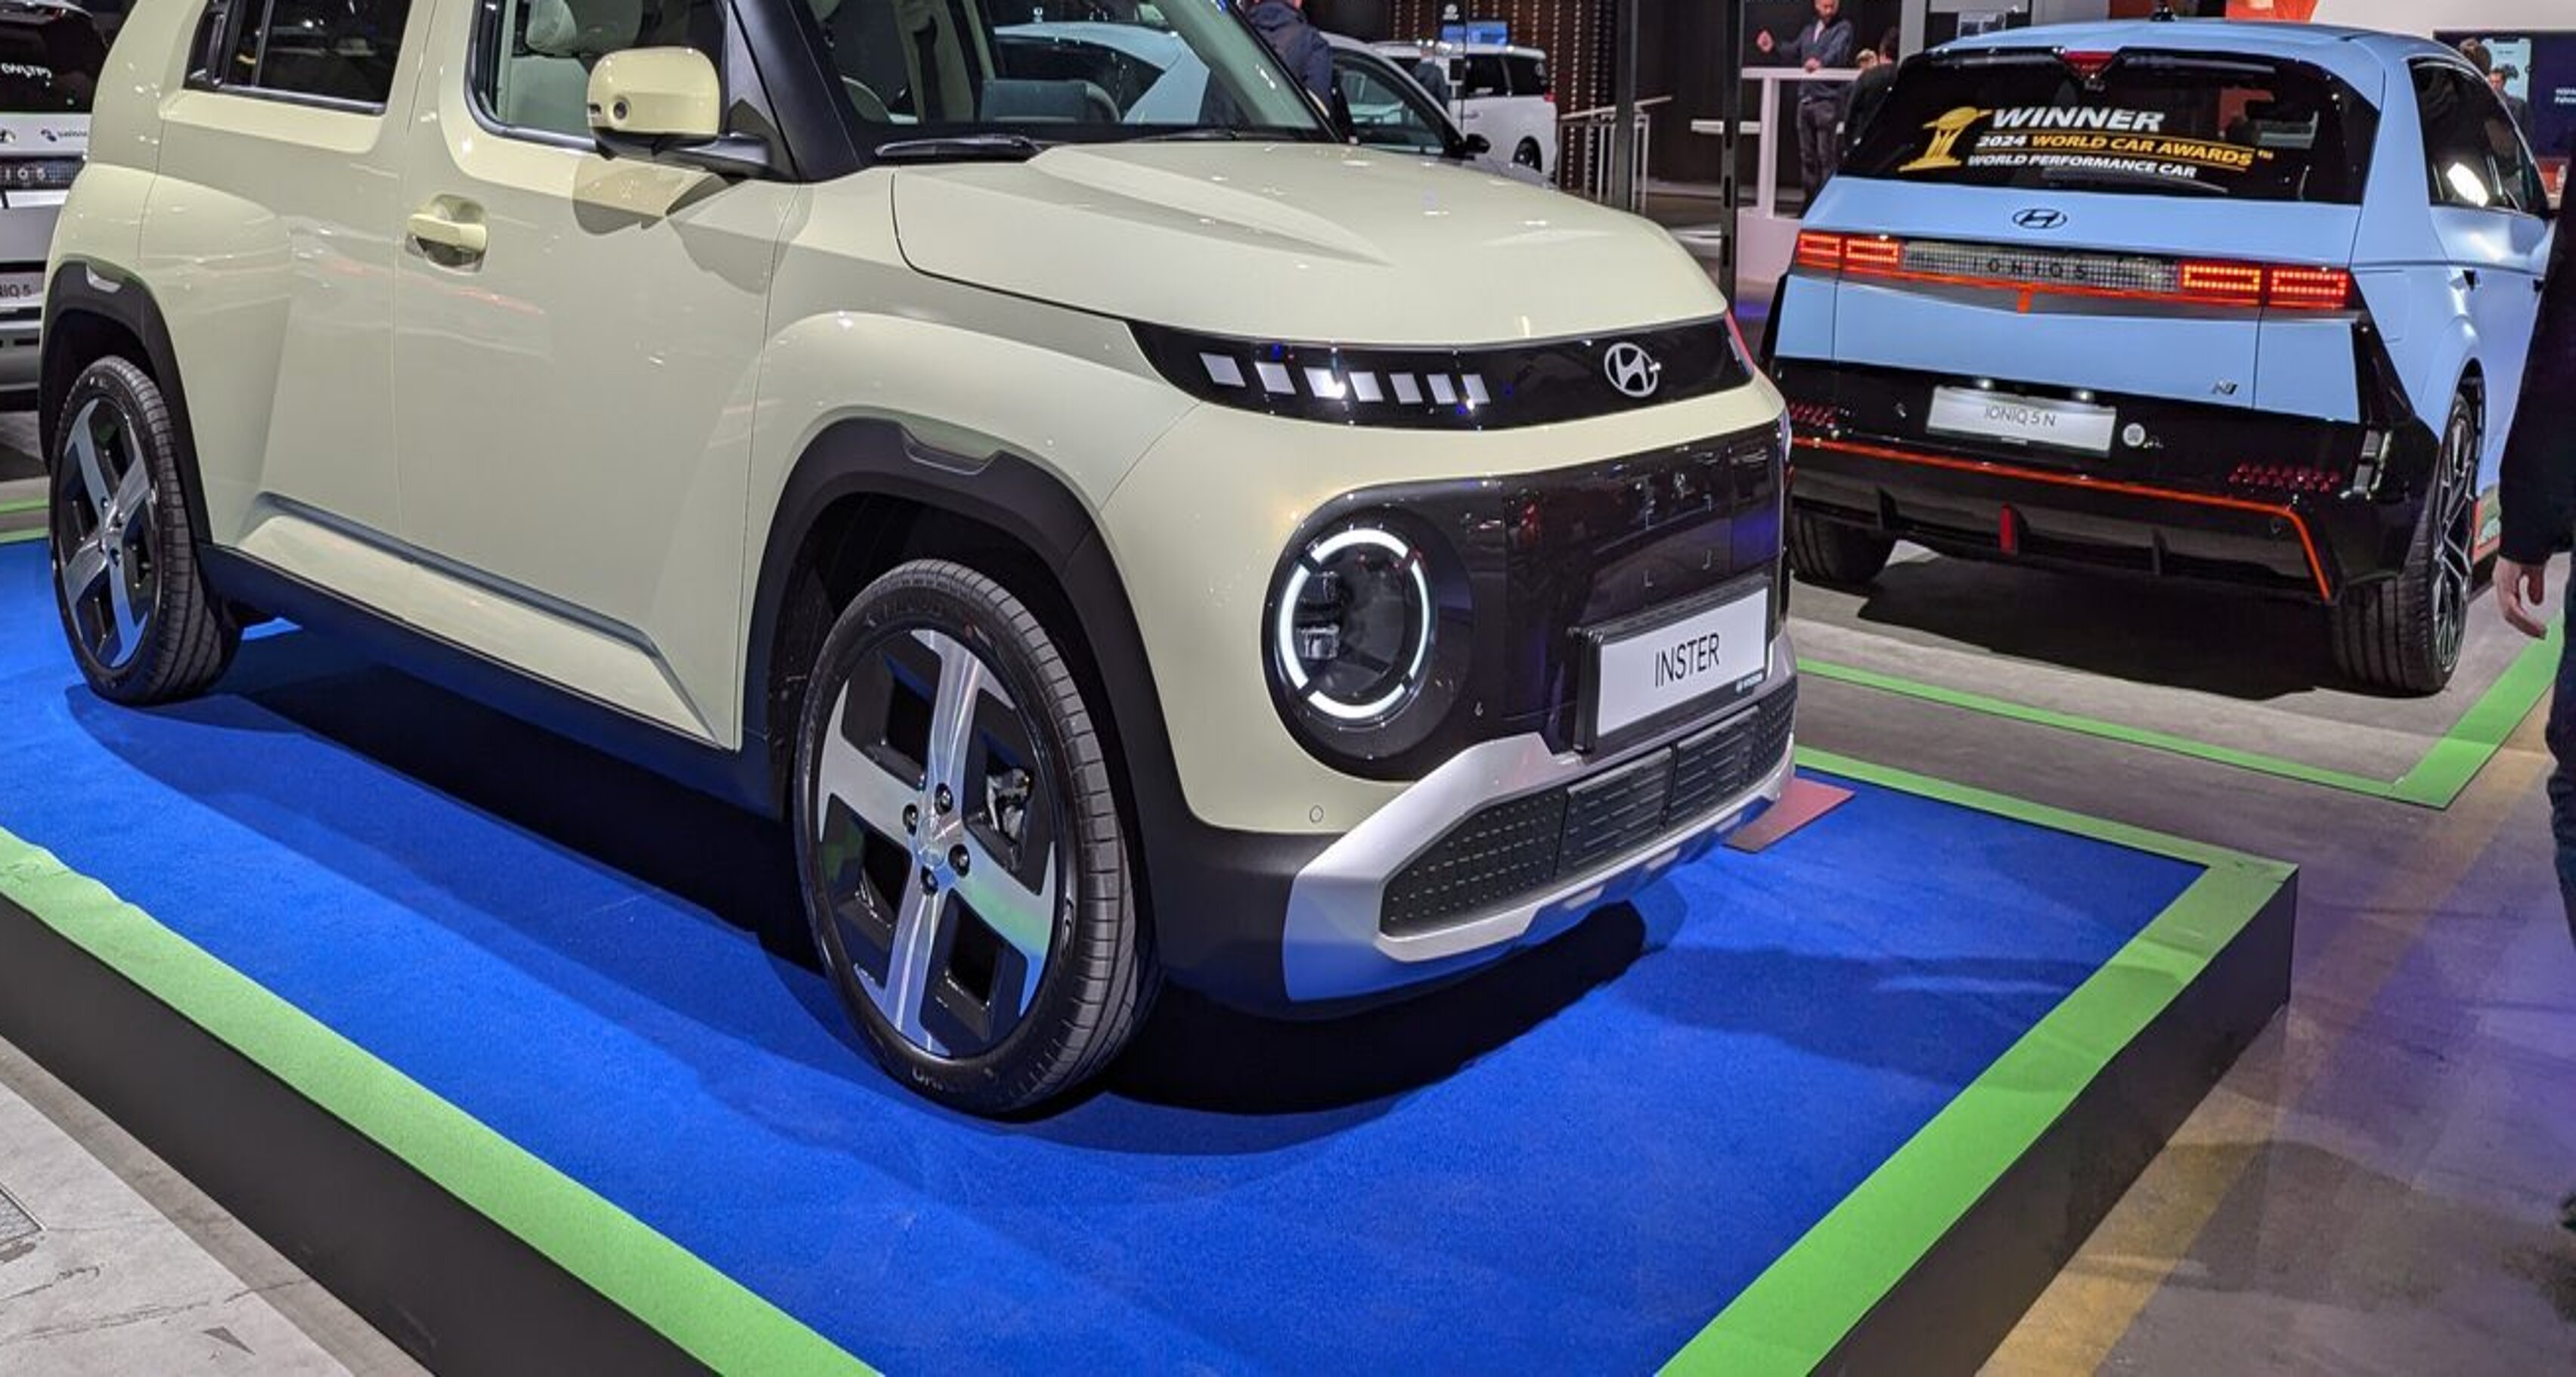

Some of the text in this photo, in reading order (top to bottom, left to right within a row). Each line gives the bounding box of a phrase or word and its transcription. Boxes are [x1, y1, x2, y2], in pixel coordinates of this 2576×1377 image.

[1993, 106, 2166, 132] WINNER
[1976, 134, 2028, 148] 2024
[2031, 134, 2106, 149] WORLD
[2109, 137, 2155, 152] CAR
[2157, 141, 2254, 167] AWARDS
[1967, 154, 2198, 178] WORLD PERFORMANCE CAR
[1984, 405, 2056, 427] IONIQ 5 N
[1654, 632, 1720, 688] INSTER
